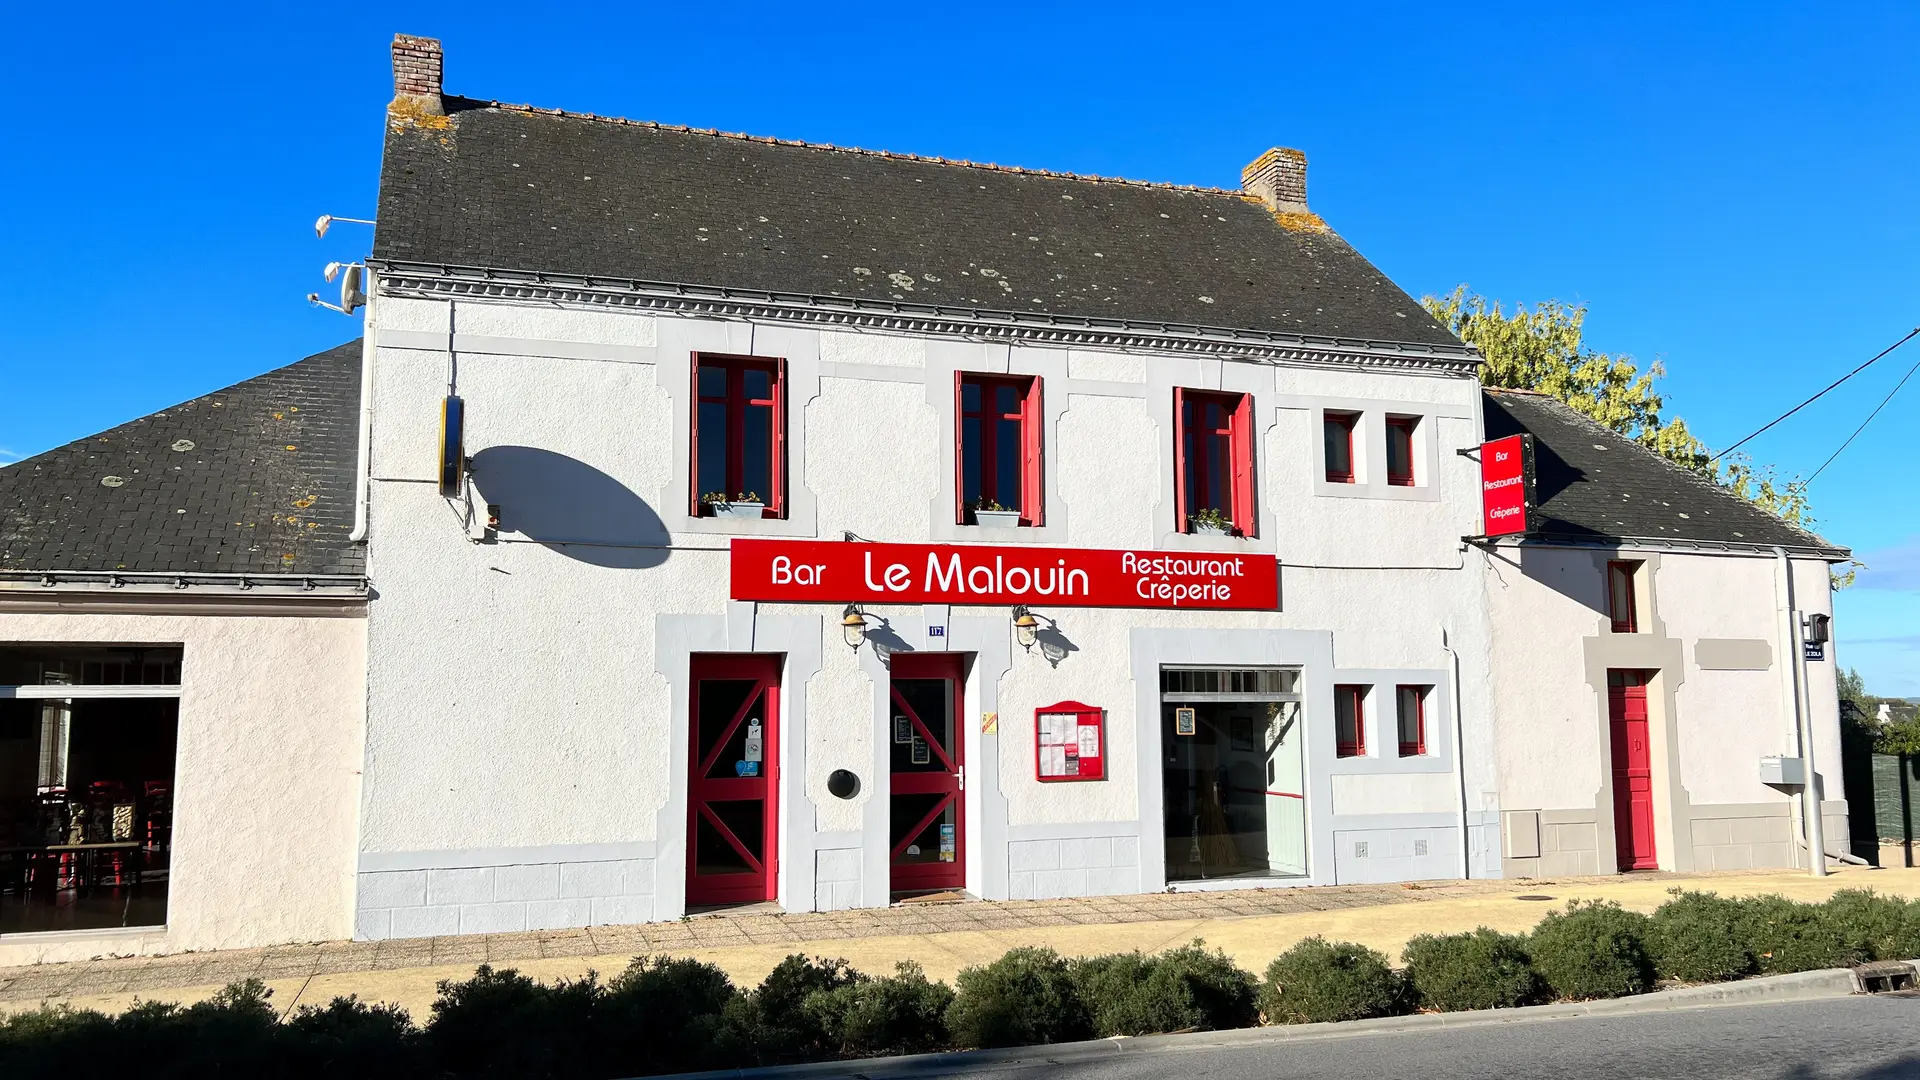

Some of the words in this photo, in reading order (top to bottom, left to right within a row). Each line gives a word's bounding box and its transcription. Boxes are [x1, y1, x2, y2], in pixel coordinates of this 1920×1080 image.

[1495, 451, 1509, 462] Bar
[1484, 474, 1523, 491] Restaurant
[1490, 506, 1521, 519] Crêperie
[771, 555, 827, 586] Bar
[864, 551, 912, 592] Le
[924, 551, 1089, 596] Malouin
[1122, 551, 1244, 577] Restaurant
[1136, 574, 1231, 606] Crêperie
[931, 627, 942, 635] 117
